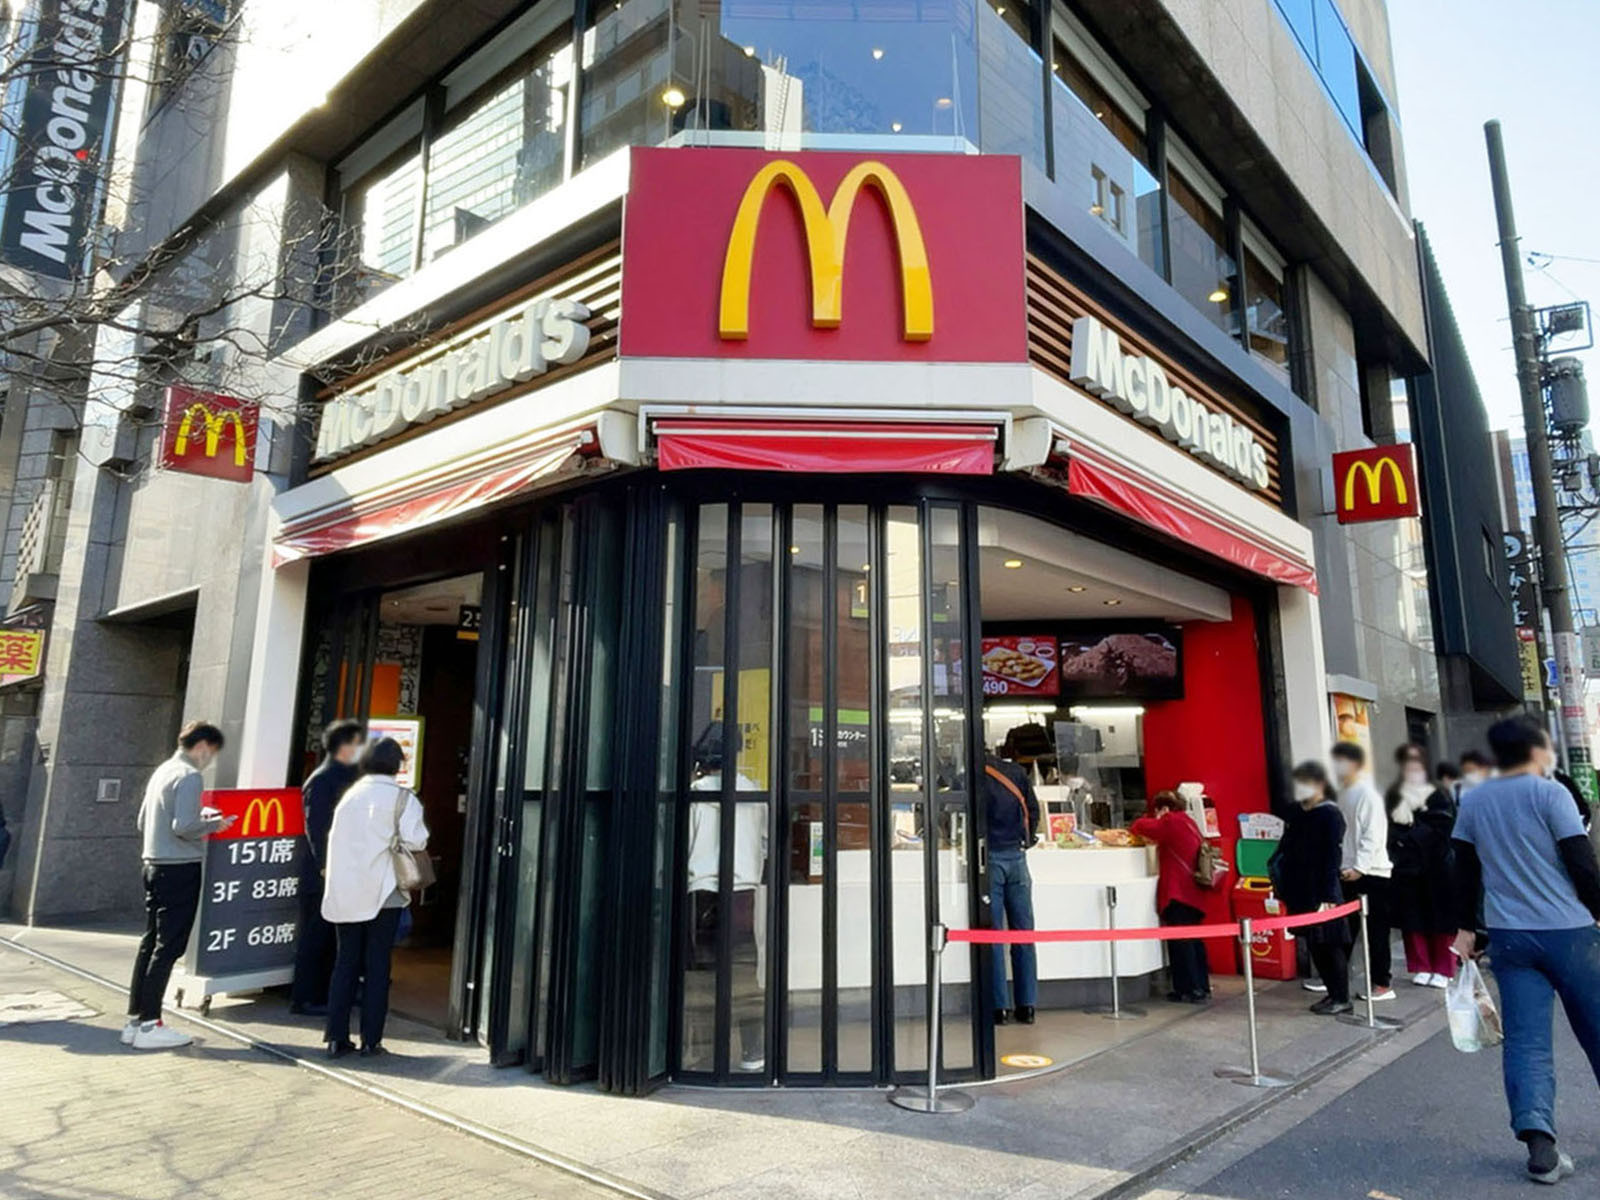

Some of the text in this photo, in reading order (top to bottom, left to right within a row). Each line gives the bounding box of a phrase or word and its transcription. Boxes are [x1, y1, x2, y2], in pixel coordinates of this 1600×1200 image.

[314, 299, 591, 462] McDonald's
[1070, 316, 1269, 490] McDonald's
[982, 680, 1009, 695] 490
[228, 838, 296, 865] 151席
[211, 876, 299, 904] 3F 83席
[206, 922, 296, 952] 2F 68席
